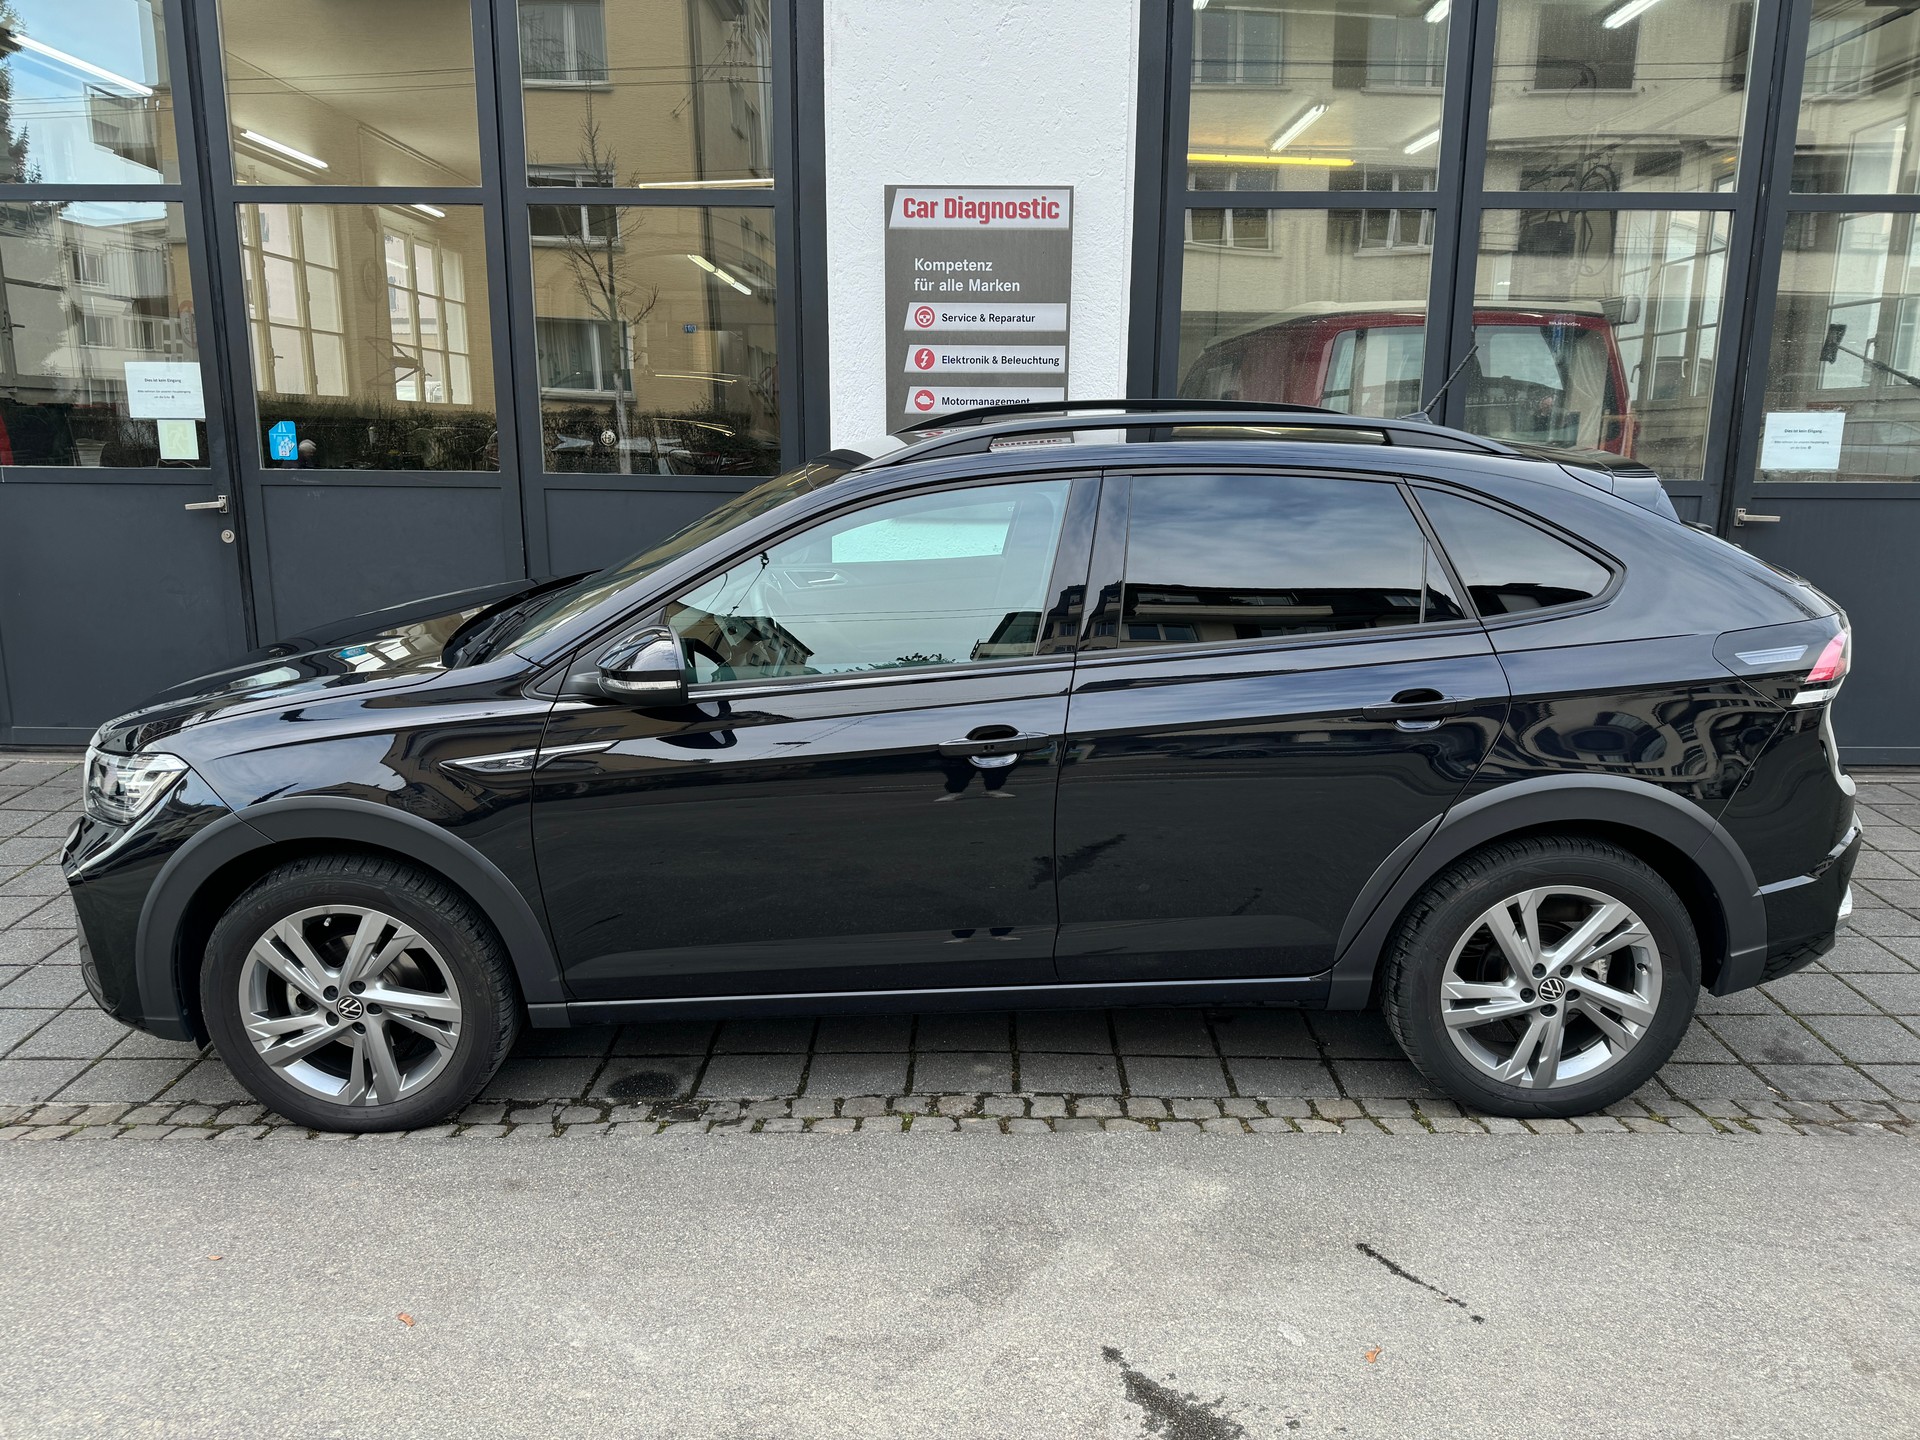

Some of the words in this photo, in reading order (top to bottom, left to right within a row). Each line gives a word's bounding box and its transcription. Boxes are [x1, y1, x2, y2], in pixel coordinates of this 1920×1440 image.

[903, 197, 938, 219] Car
[944, 196, 1060, 224] Diagnostic
[914, 258, 993, 274] Kompetenz
[914, 277, 934, 292] für
[939, 278, 964, 292] alle
[968, 278, 1020, 292] Marken
[941, 313, 977, 323] Service
[979, 313, 986, 323] &
[988, 313, 1036, 325] Reparatur
[941, 355, 989, 365] Elektronik
[991, 356, 999, 365] &
[1001, 355, 1060, 367] Beleuchtung
